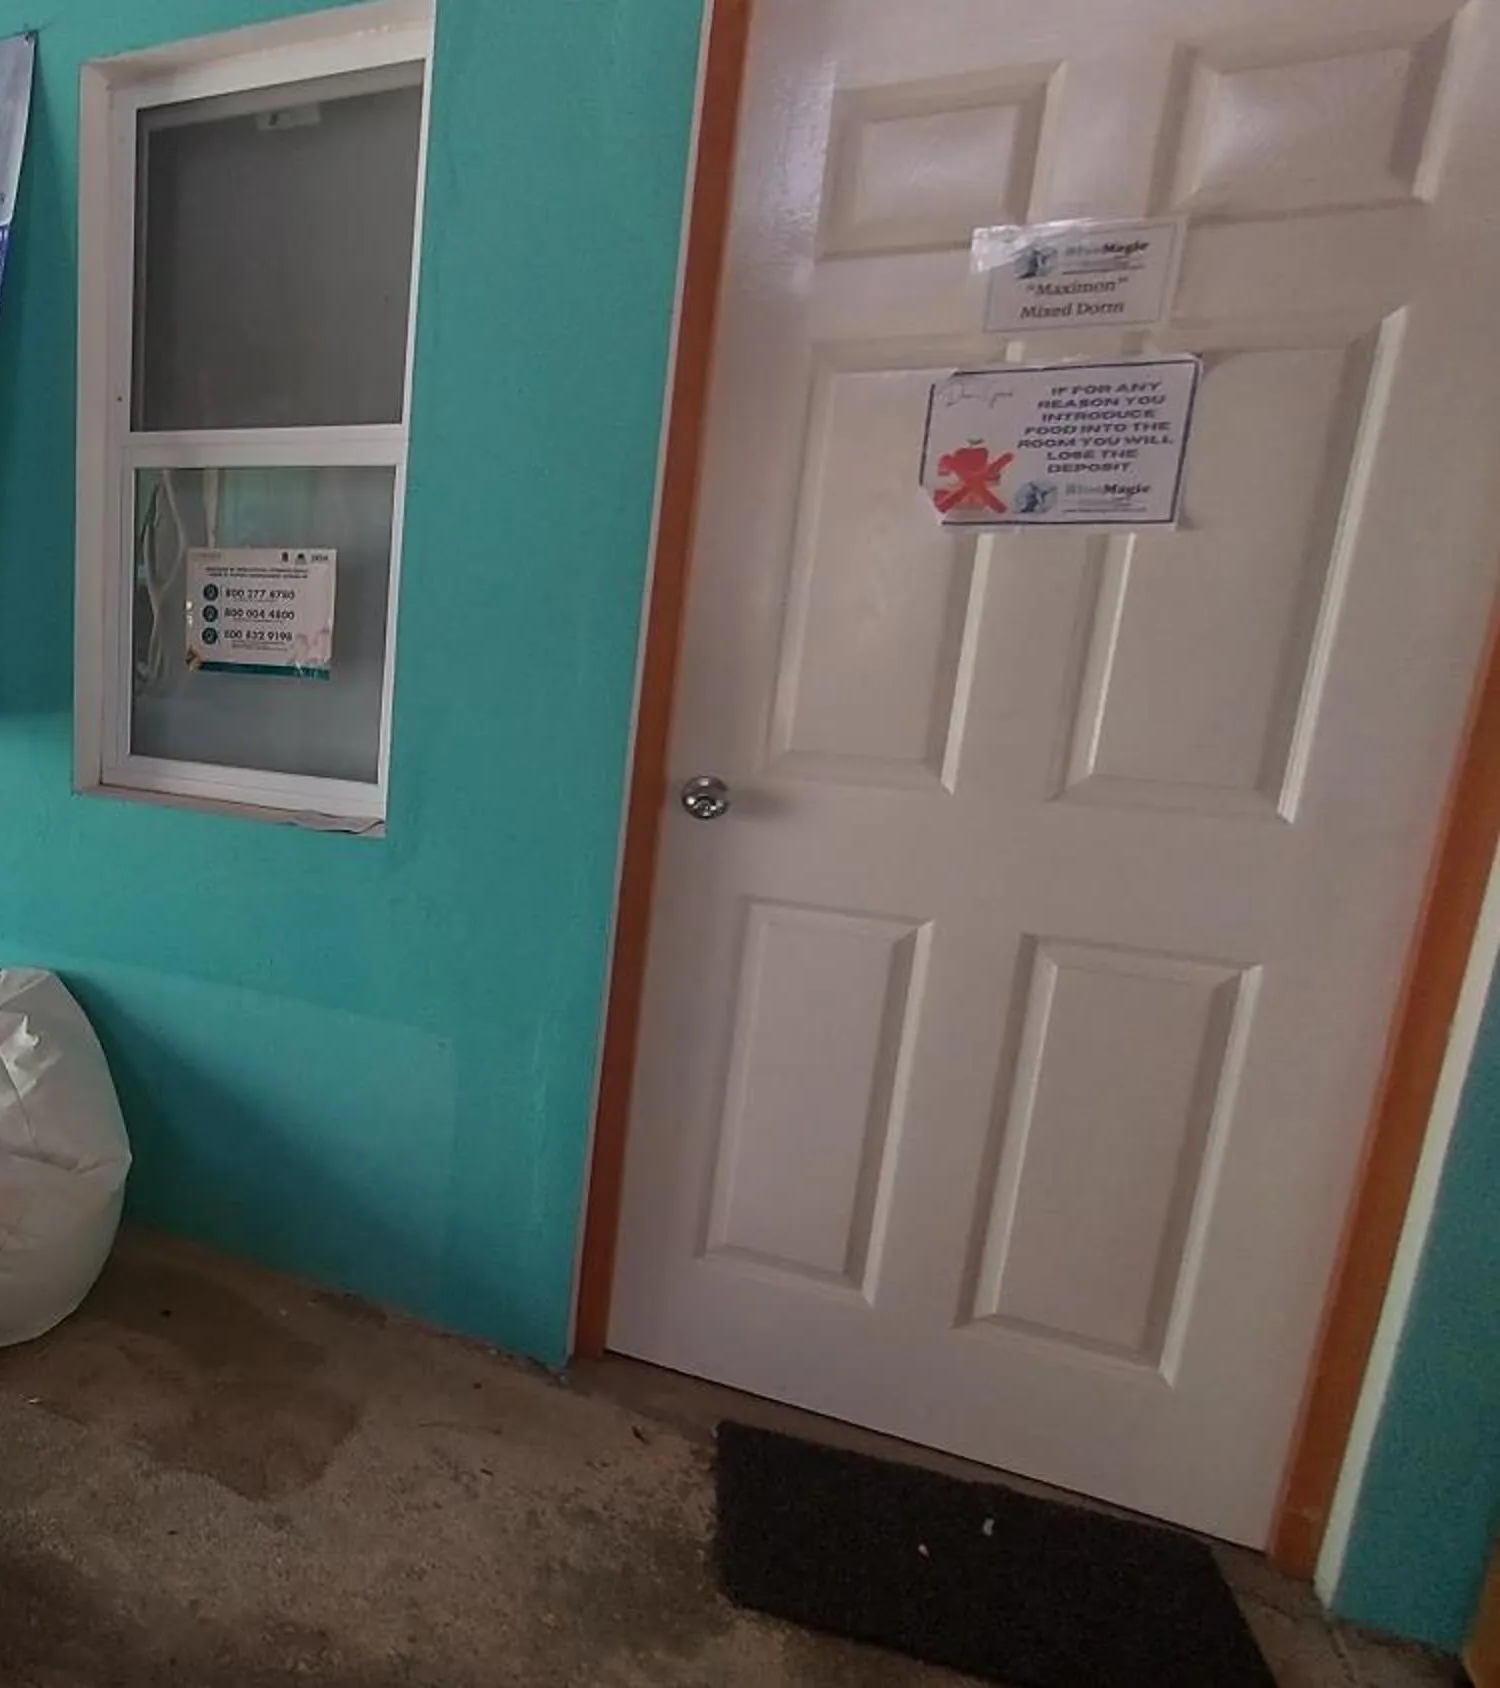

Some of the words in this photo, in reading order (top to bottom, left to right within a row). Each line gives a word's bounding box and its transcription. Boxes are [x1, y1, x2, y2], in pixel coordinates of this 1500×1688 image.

[1019, 301, 1071, 319] Mixed
[1075, 300, 1125, 316] Dorm
[1051, 386, 1067, 396] IF
[1071, 384, 1112, 395] FOR
[1115, 381, 1162, 393] ANY
[1037, 398, 1120, 409] REASON
[1125, 395, 1167, 405] YOU
[1042, 409, 1155, 422] INTRODUCE
[1024, 425, 1077, 435] FOOD
[1080, 423, 1127, 433] INTO
[1133, 421, 1171, 432] THE
[1017, 438, 1076, 449] ROOM
[1080, 437, 1121, 447] YOU
[1123, 435, 1173, 445] WILL
[1047, 451, 1095, 461] LOSE
[1101, 449, 1139, 460] THE
[1047, 462, 1132, 473] DEPOSIT
[224, 608, 244, 617] 800
[268, 609, 295, 620] 4800
